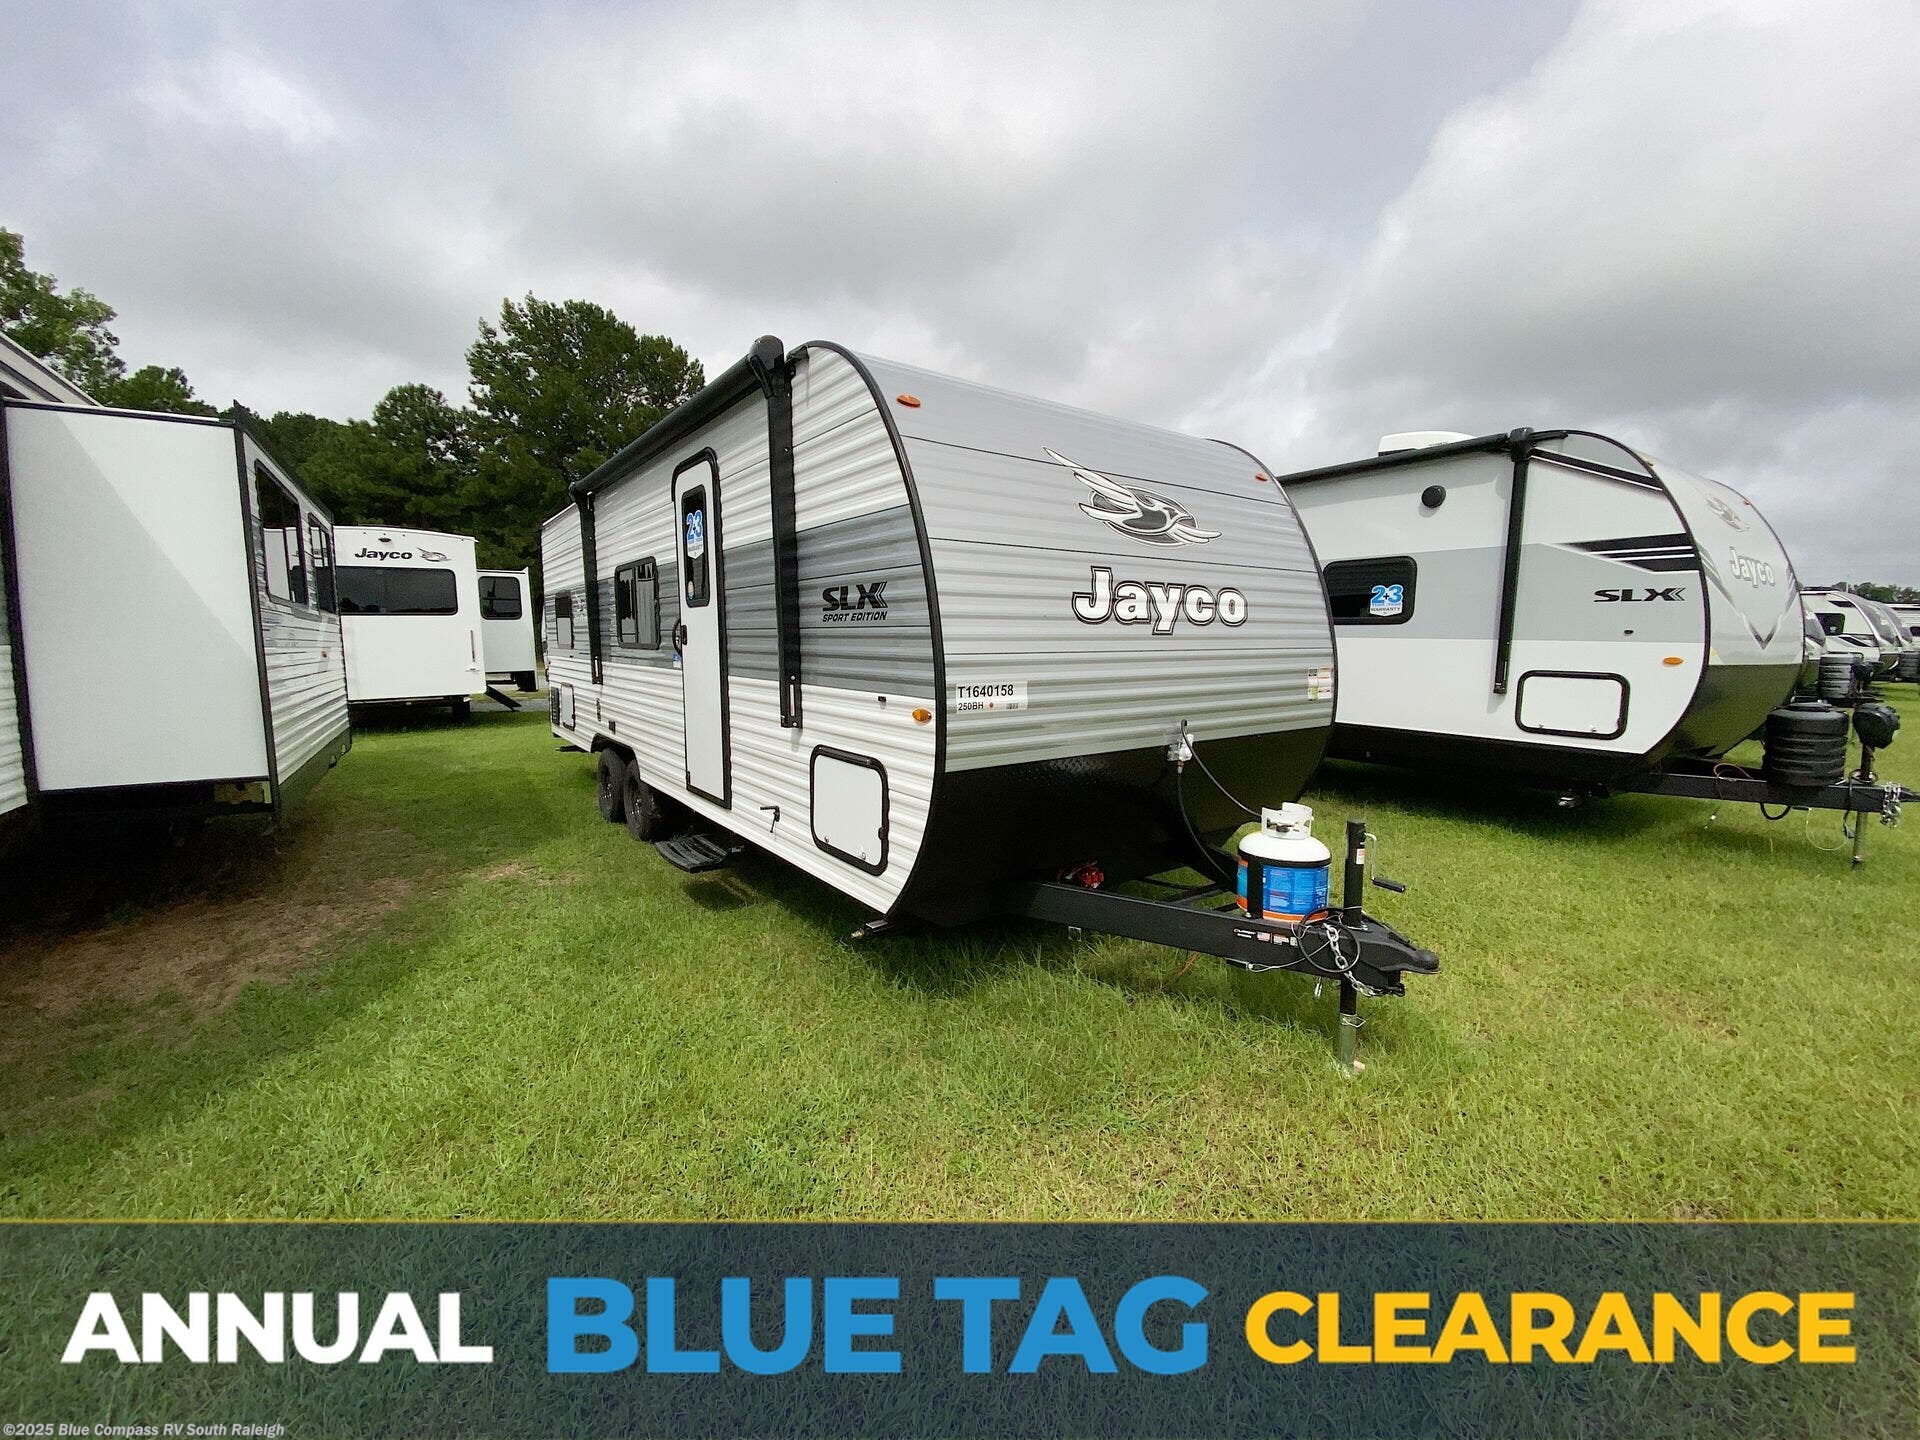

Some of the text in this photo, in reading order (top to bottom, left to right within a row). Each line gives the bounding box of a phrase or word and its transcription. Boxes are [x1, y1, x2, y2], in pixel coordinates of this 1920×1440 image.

[354, 547, 413, 560] Jayco
[1729, 545, 1776, 588] Jayco
[822, 581, 888, 611] SLX
[1071, 565, 1248, 636] Jayco
[1594, 587, 1686, 602] SLX
[822, 611, 888, 622] SPORT EDITION
[957, 684, 1014, 698] T1640158
[957, 702, 984, 711] 250BH
